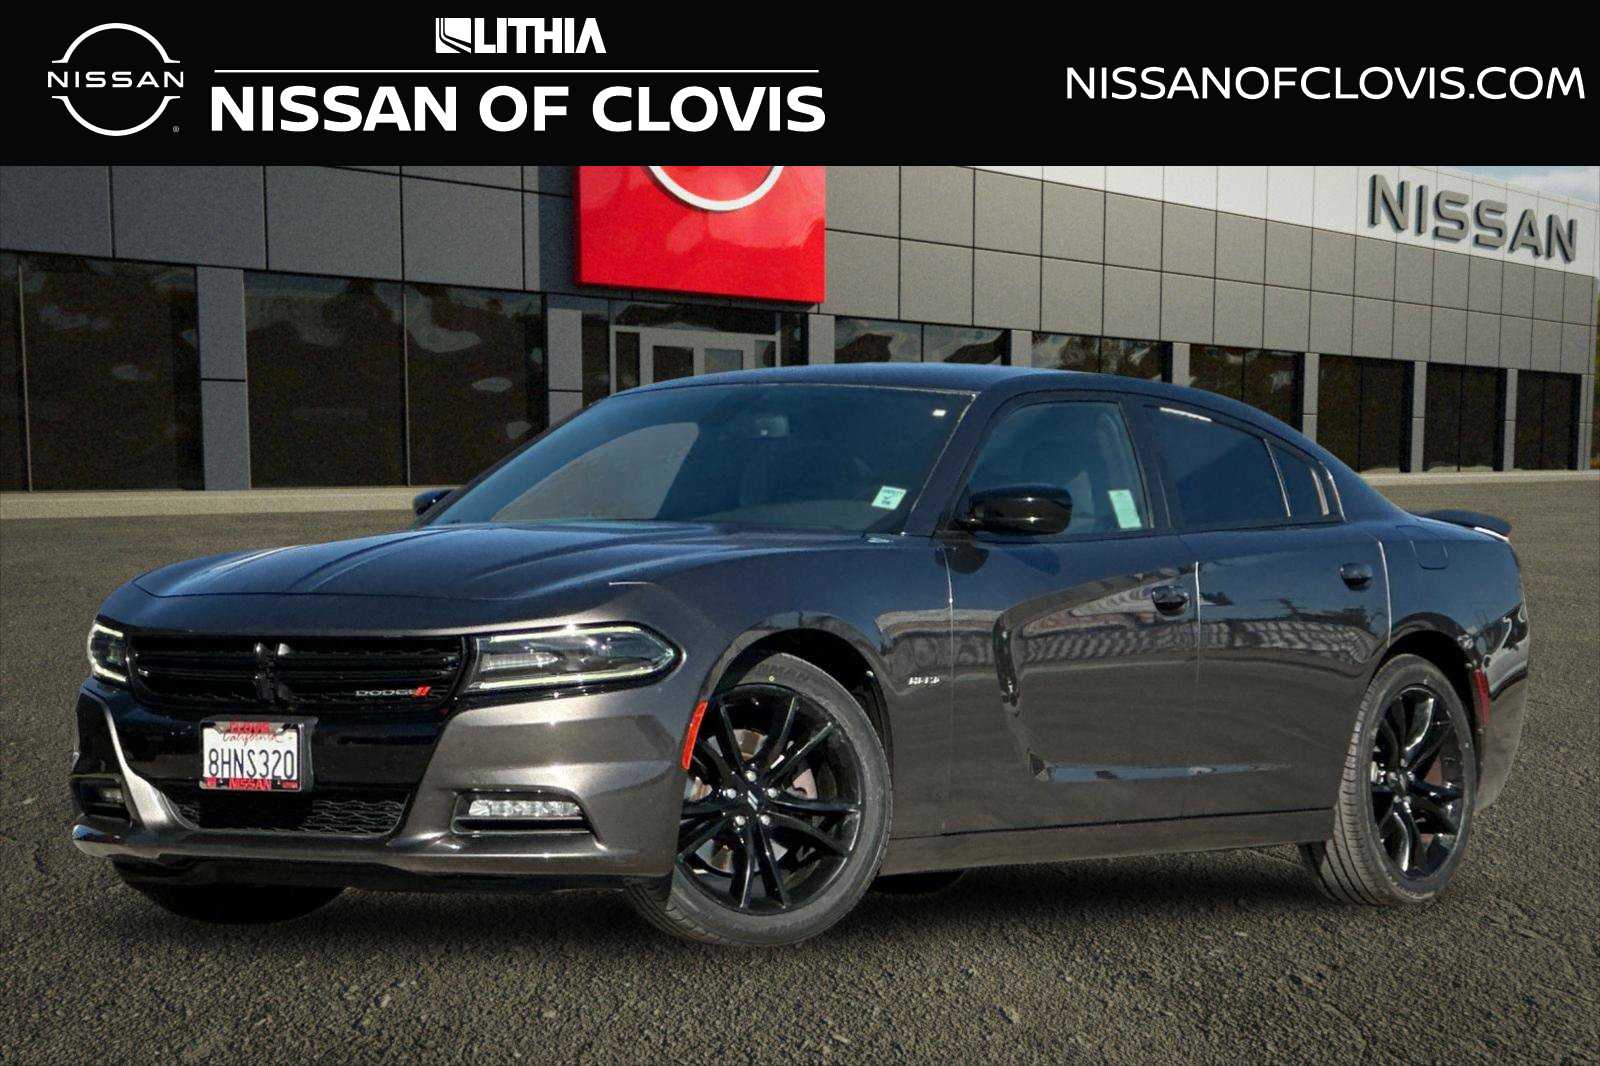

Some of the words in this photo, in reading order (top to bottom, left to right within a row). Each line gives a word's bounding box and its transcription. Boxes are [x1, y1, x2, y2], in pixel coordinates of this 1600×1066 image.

[1368, 174, 1577, 263] NISSAN
[355, 689, 417, 697] DODGE
[208, 748, 295, 780] 8HNS320
